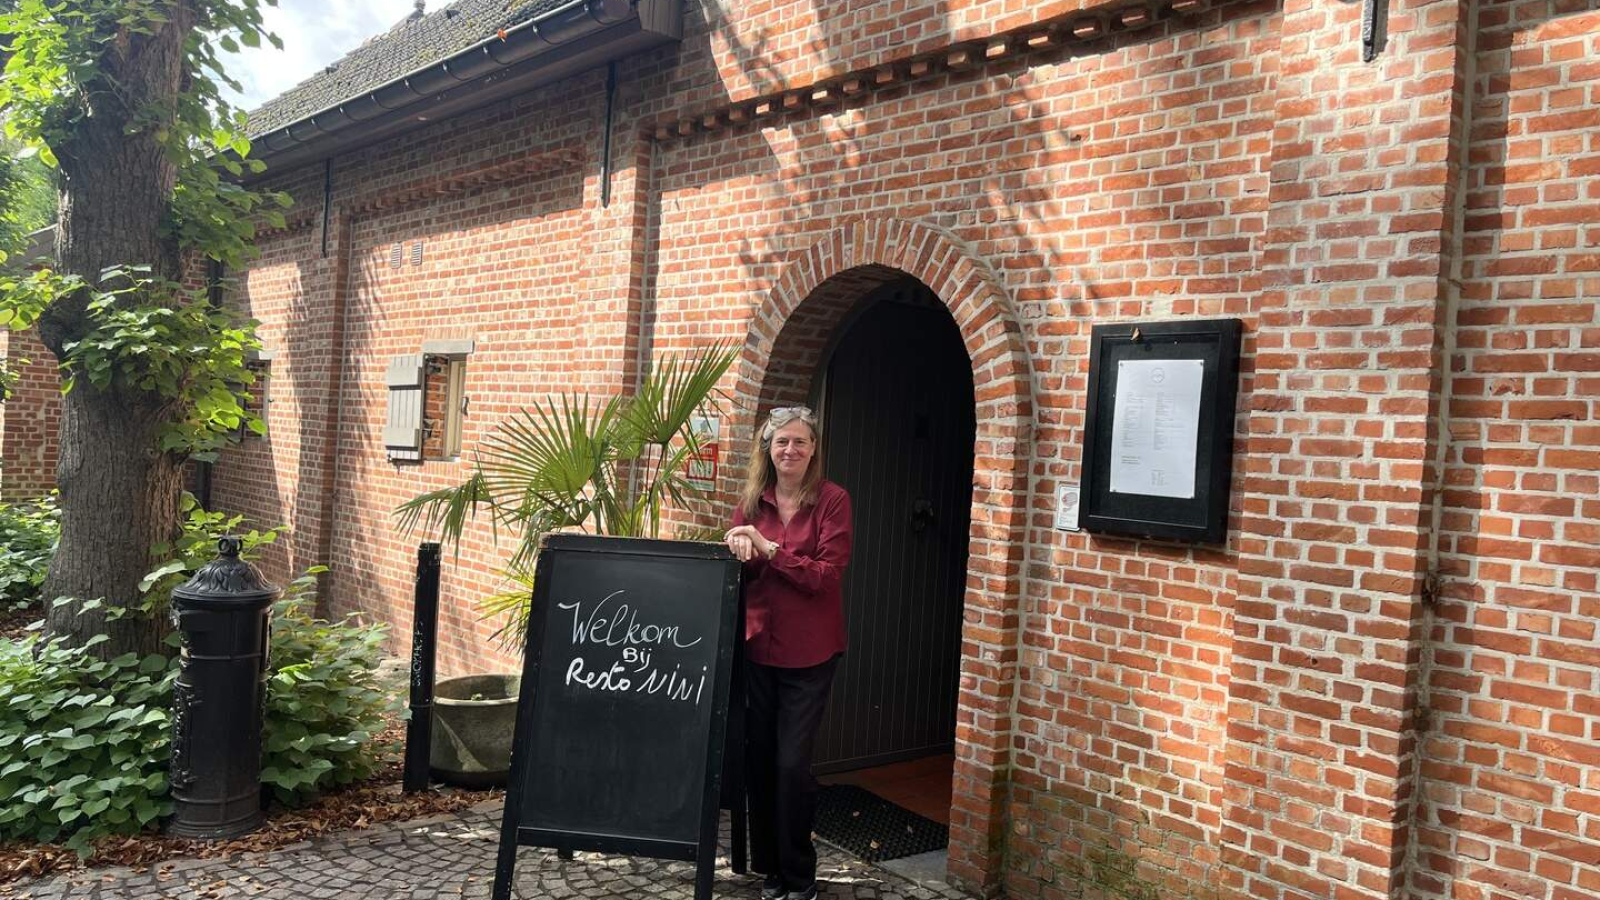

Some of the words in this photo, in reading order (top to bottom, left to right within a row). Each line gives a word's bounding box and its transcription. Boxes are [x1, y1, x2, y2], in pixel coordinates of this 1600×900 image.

[557, 590, 702, 648] Welkom
[565, 657, 631, 691] Resto
[622, 647, 652, 673] Bij
